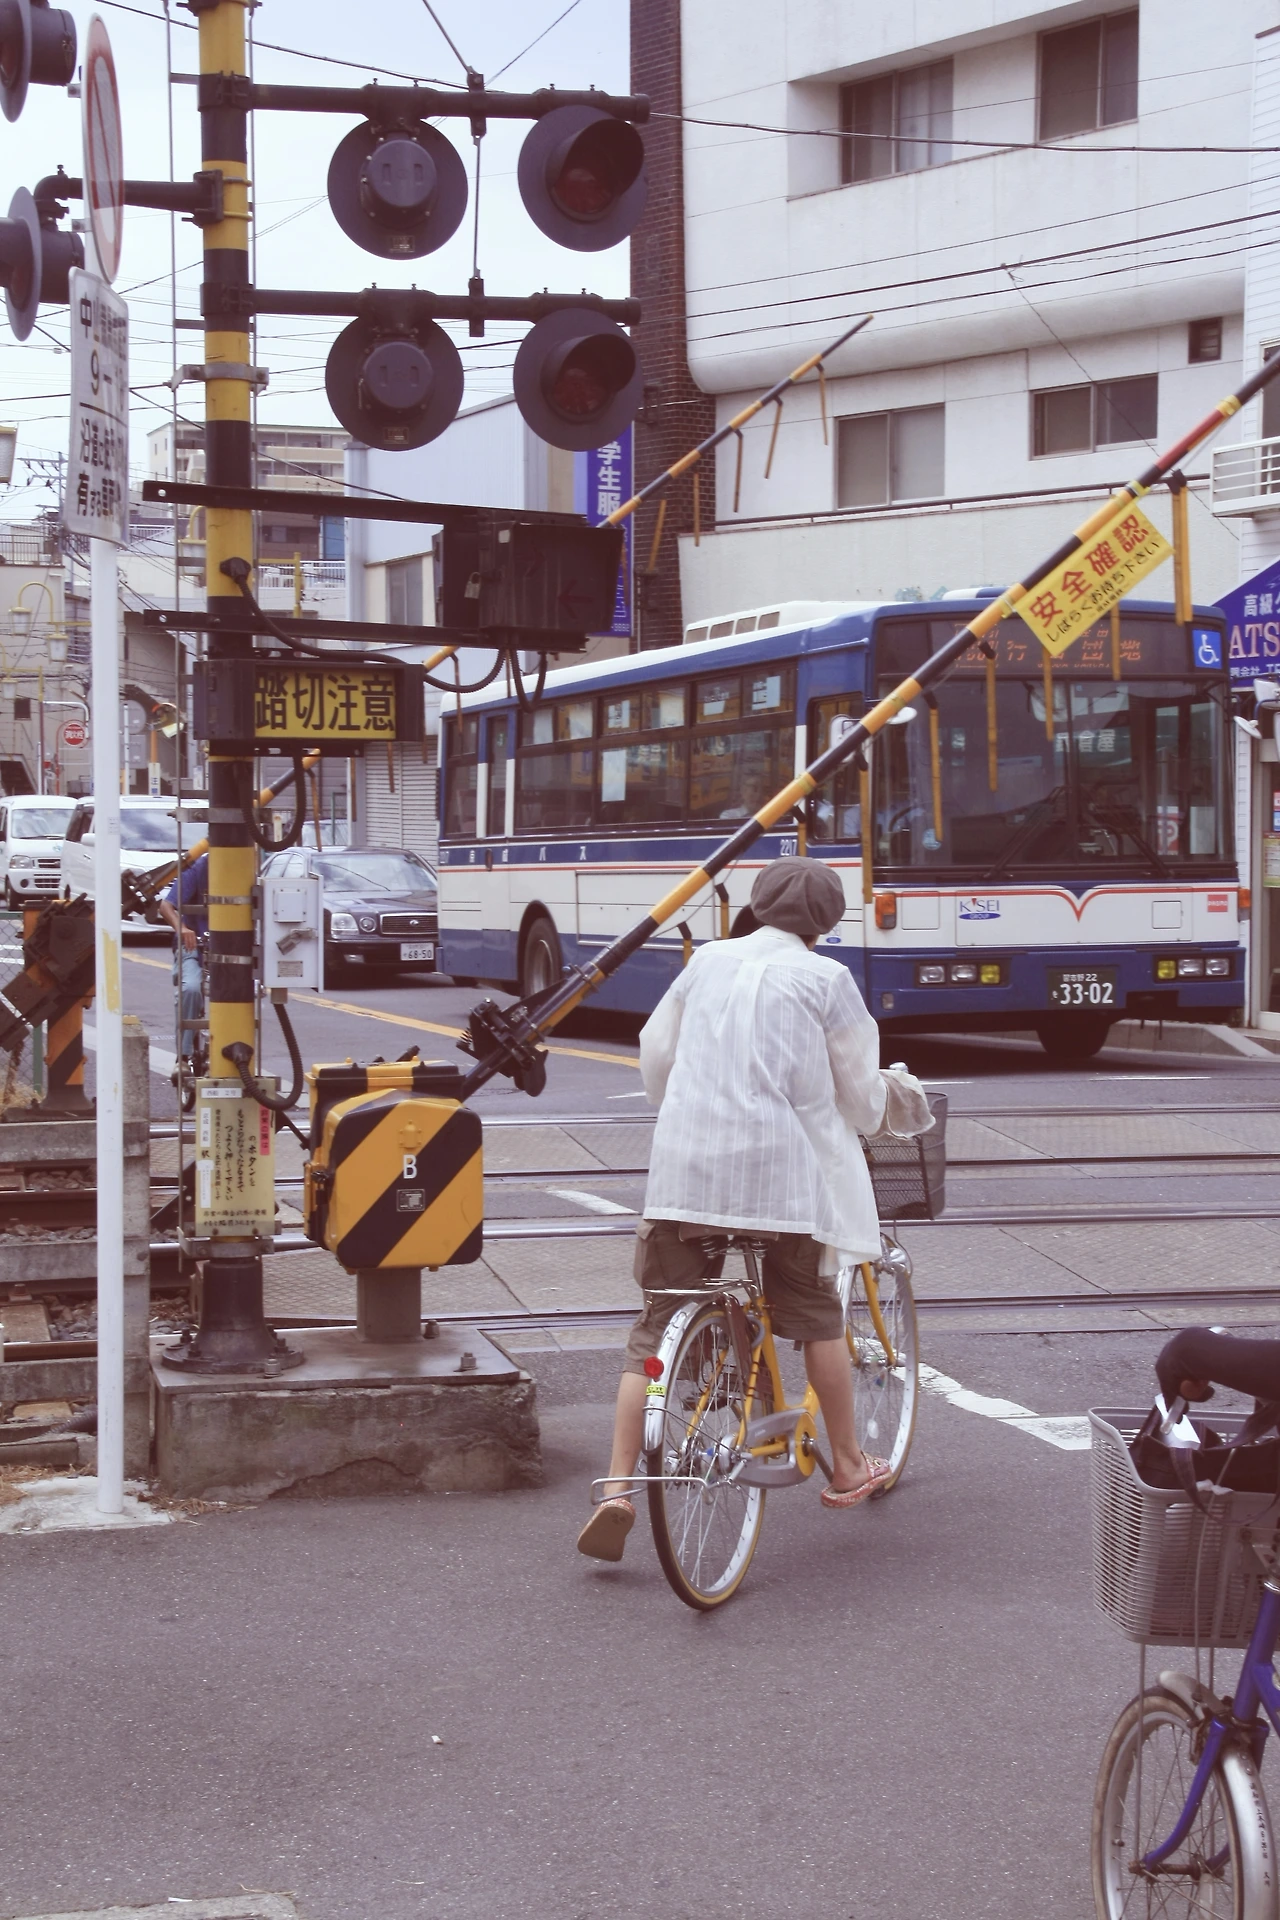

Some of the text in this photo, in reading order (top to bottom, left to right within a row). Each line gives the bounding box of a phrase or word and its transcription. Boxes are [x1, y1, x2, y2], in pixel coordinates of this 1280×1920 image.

[597, 441, 622, 517] 学生服
[1029, 514, 1150, 628] 安全確認
[1046, 542, 1160, 642] しばらくお待ち下さい
[254, 672, 397, 733] 踏切注意
[780, 839, 798, 856] 2217
[408, 949, 432, 959] 68-50
[1085, 973, 1098, 981] 22
[1059, 982, 1114, 1005] 33-02
[403, 1154, 417, 1179] B
